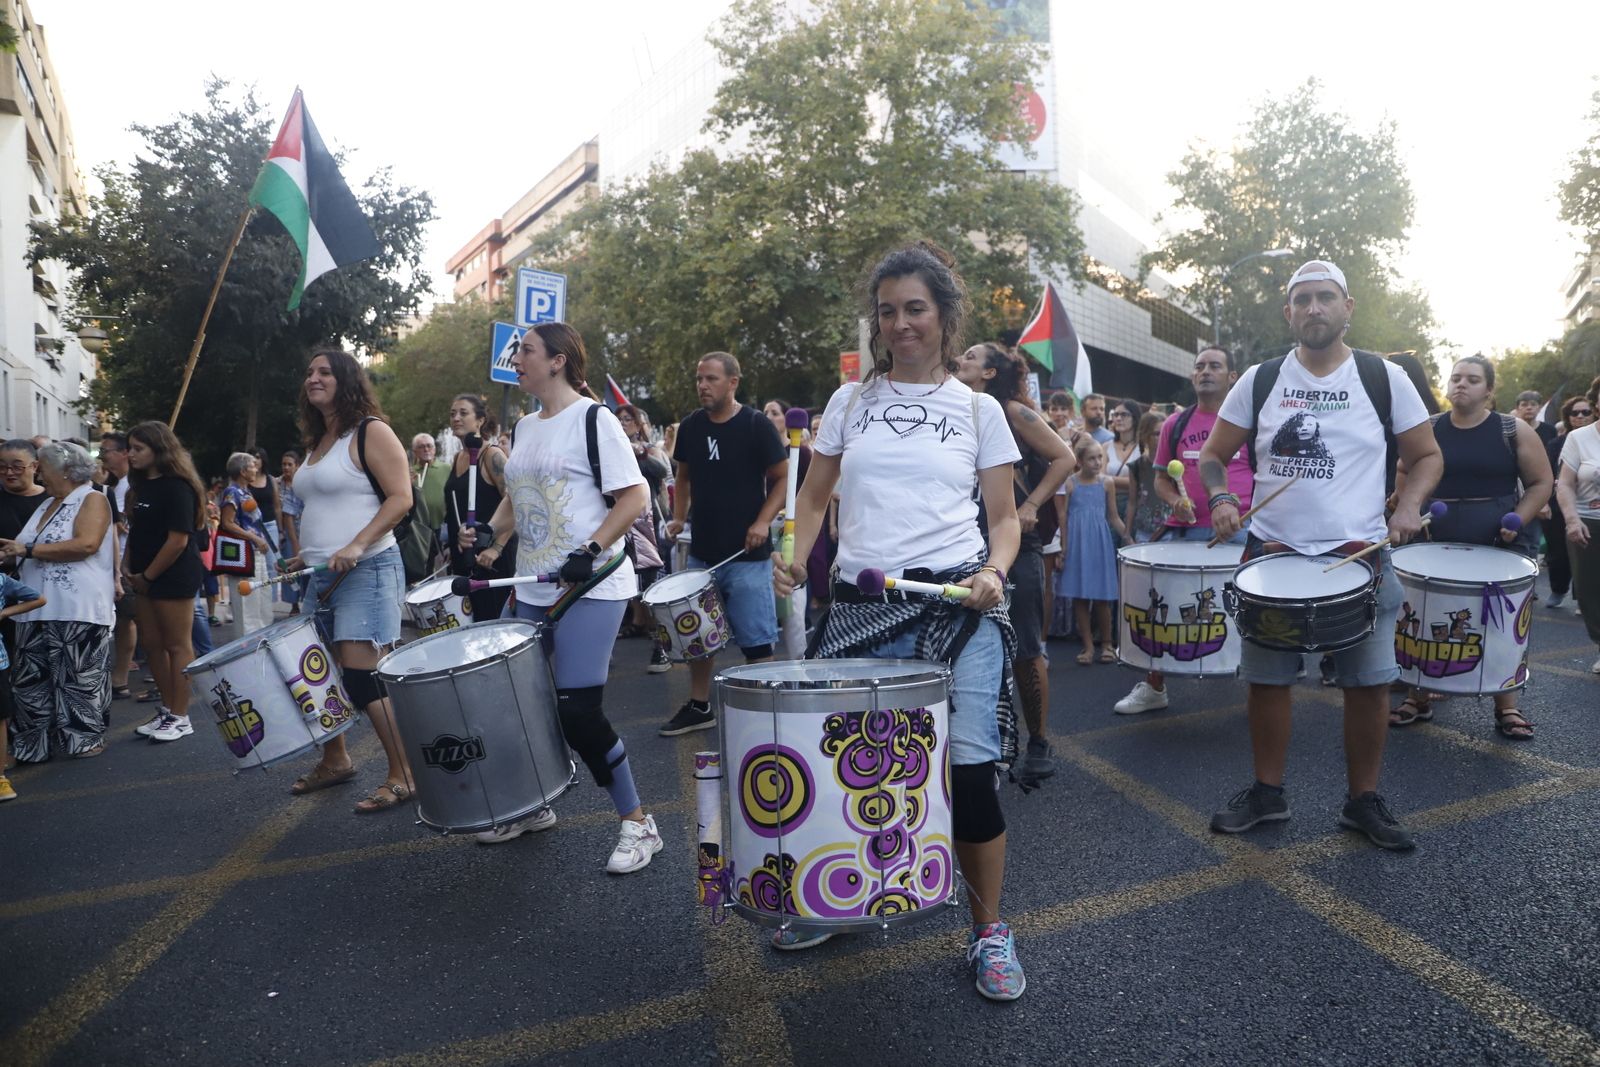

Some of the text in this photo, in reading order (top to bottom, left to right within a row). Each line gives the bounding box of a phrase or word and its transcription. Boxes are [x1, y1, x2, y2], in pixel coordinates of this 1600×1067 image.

[530, 290, 551, 321] P
[1283, 387, 1349, 402] LIBERTAD
[1287, 457, 1336, 468] PRESOS
[1269, 463, 1335, 480] PALESTINOS
